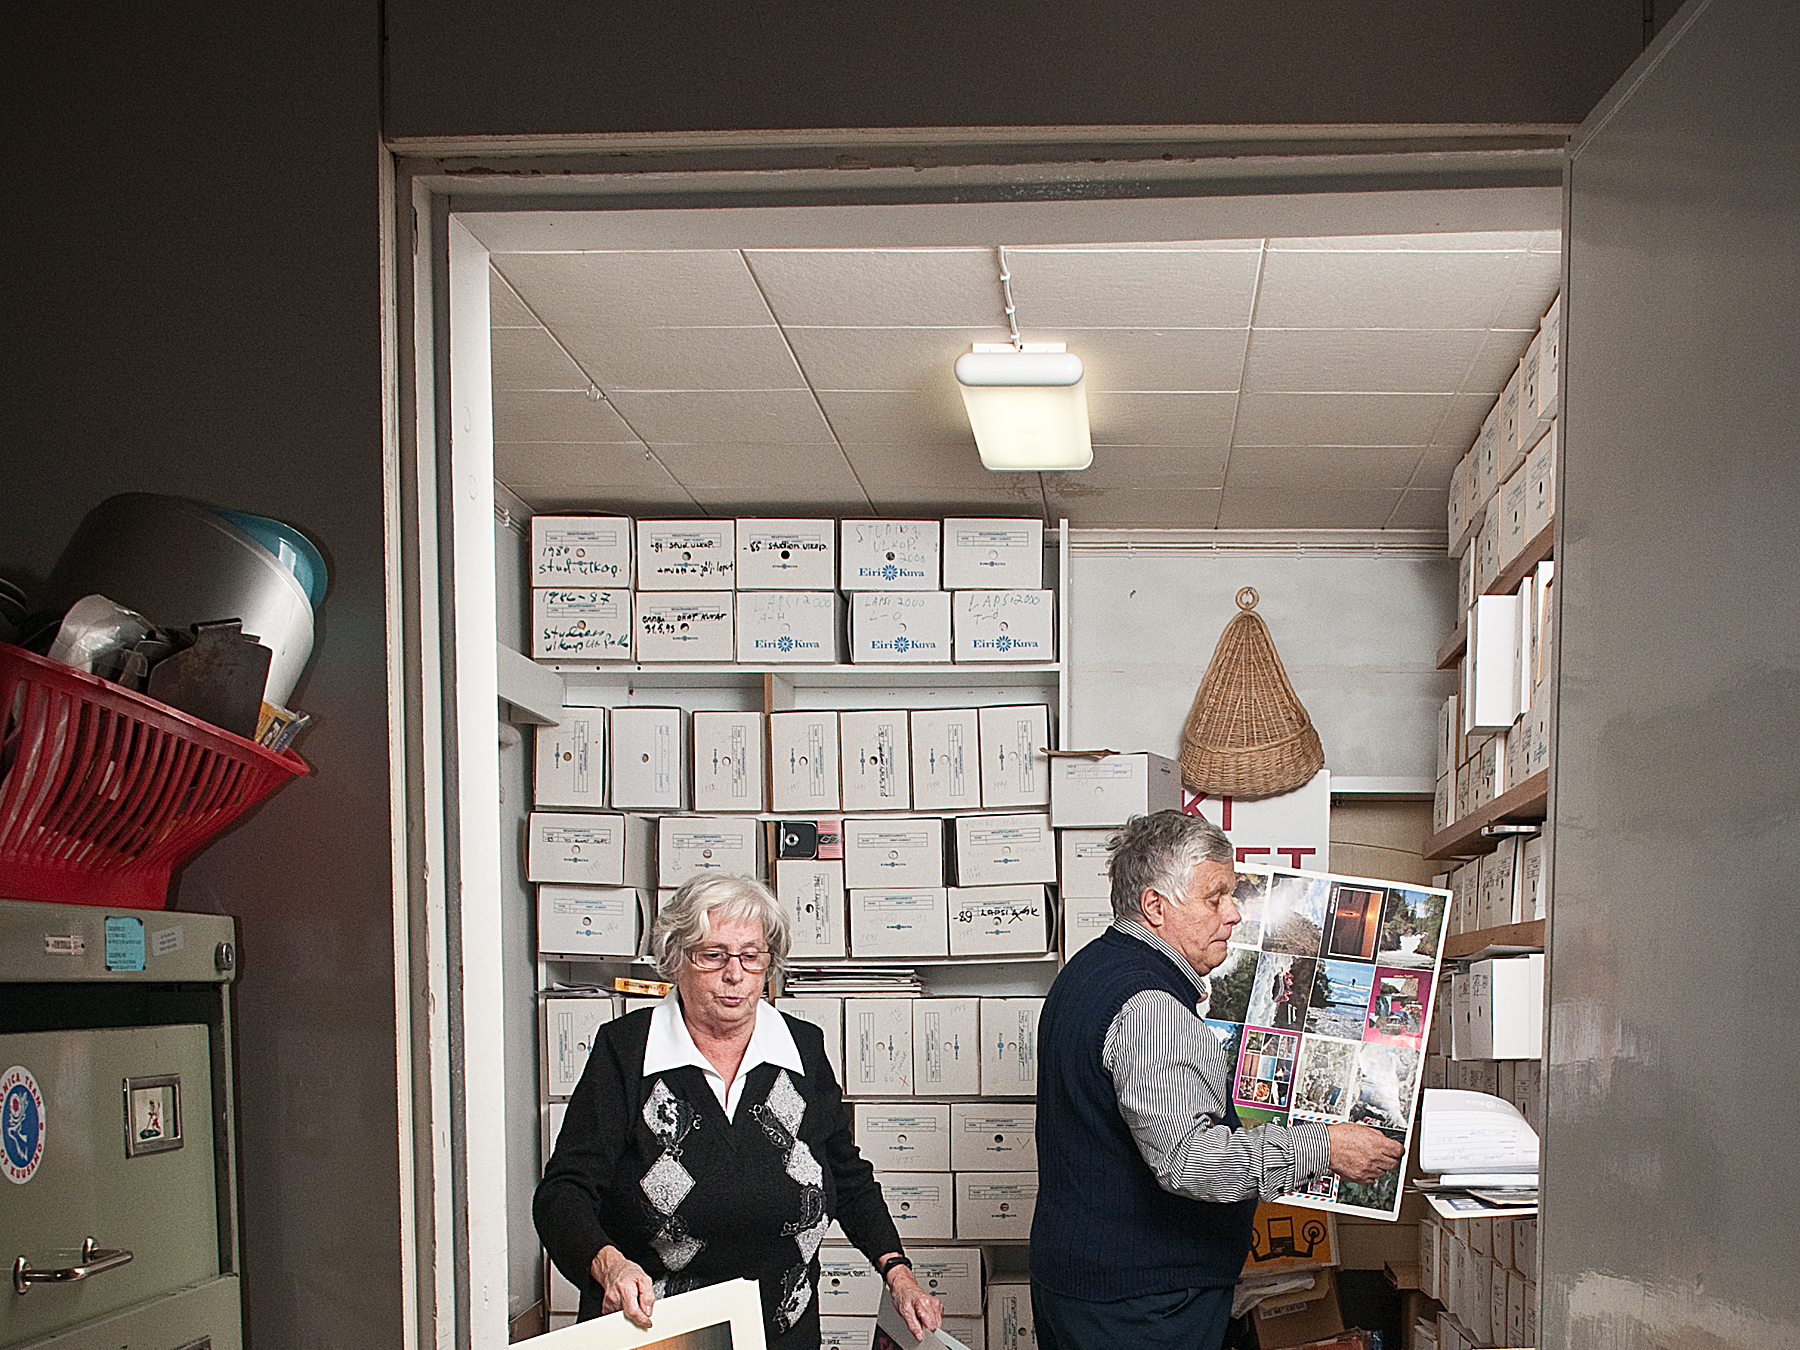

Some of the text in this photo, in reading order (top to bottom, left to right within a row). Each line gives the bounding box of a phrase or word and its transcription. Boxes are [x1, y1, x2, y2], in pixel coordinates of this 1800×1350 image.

[859, 567, 925, 577] Eiri Kuva
[755, 639, 820, 649] Eiri Kuva
[871, 640, 936, 649] Eiri Kuva
[973, 639, 1038, 648] Eiri Kuva
